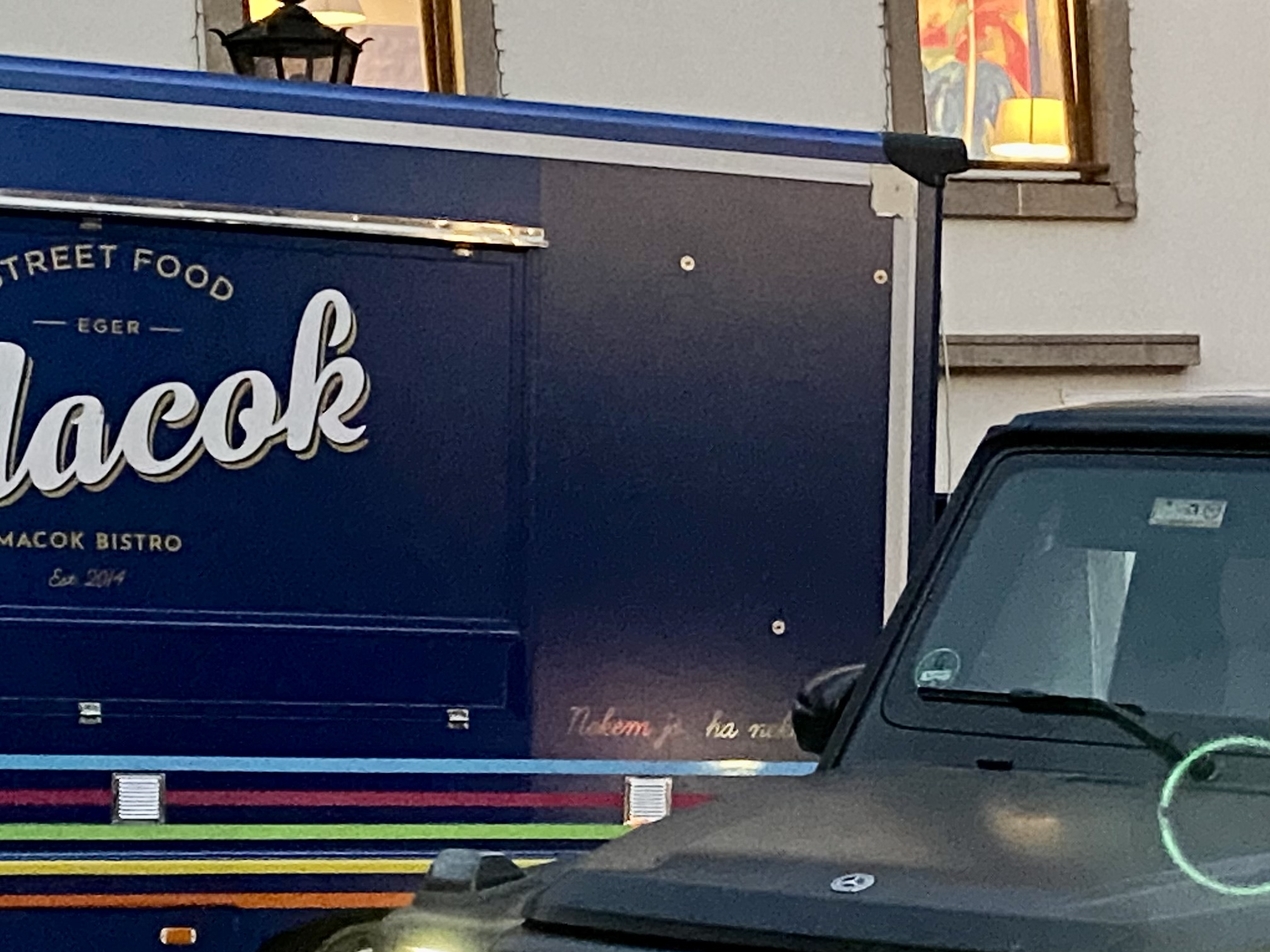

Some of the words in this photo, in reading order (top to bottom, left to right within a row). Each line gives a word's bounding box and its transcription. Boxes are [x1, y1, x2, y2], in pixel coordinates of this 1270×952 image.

[0, 244, 118, 289] TREET
[133, 248, 234, 301] FOOD
[77, 317, 141, 335] EGER
[0, 288, 371, 507] acok
[95, 533, 183, 552] BISTRO
